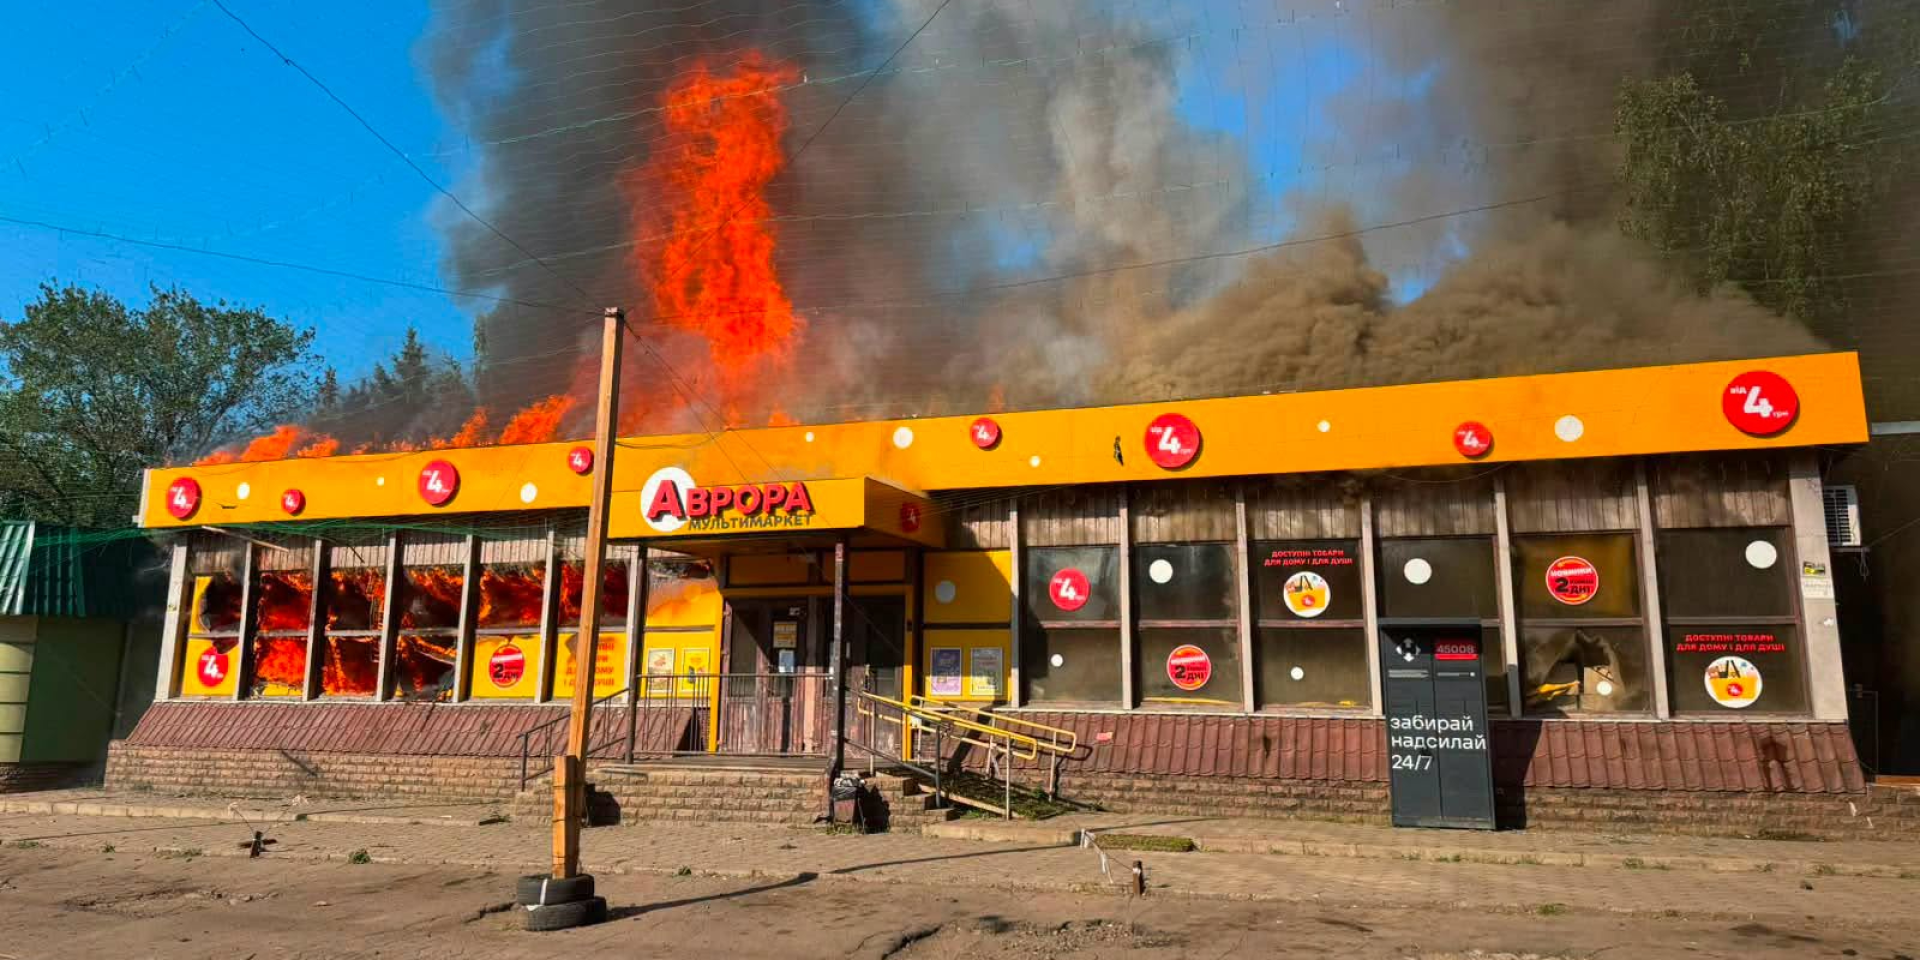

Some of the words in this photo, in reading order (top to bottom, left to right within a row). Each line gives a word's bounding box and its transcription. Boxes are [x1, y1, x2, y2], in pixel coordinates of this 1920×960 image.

[1744, 386, 1773, 418] 4
[977, 425, 989, 440] 4
[1159, 426, 1181, 454] 4
[1463, 430, 1479, 448] 4
[573, 453, 583, 466] 4
[427, 470, 442, 492] 4
[173, 486, 187, 508] 4
[647, 479, 814, 521] АВРОРА
[689, 514, 811, 530] МУЛЬТИМАРКЕТ
[1264, 558, 1281, 566] ДЛЯ
[1283, 558, 1305, 566] ДОМУ
[1060, 577, 1077, 601] 4
[1555, 577, 1569, 593] 2
[1570, 585, 1590, 594] ДНІ
[1685, 634, 1733, 642] ДОСТУПНІ
[1735, 634, 1774, 642] ТОВАРИ
[1676, 643, 1696, 652] ДЛЯ
[1699, 643, 1728, 652] ДОМУ
[1735, 643, 1756, 652] ДЛЯ
[1758, 643, 1785, 652] ДУШІ
[203, 655, 219, 678] 4
[493, 663, 503, 678] 2
[1175, 665, 1186, 679] 2
[1390, 715, 1473, 733] забирай
[1391, 734, 1487, 750] надсилай
[1392, 755, 1433, 770] 24/7
